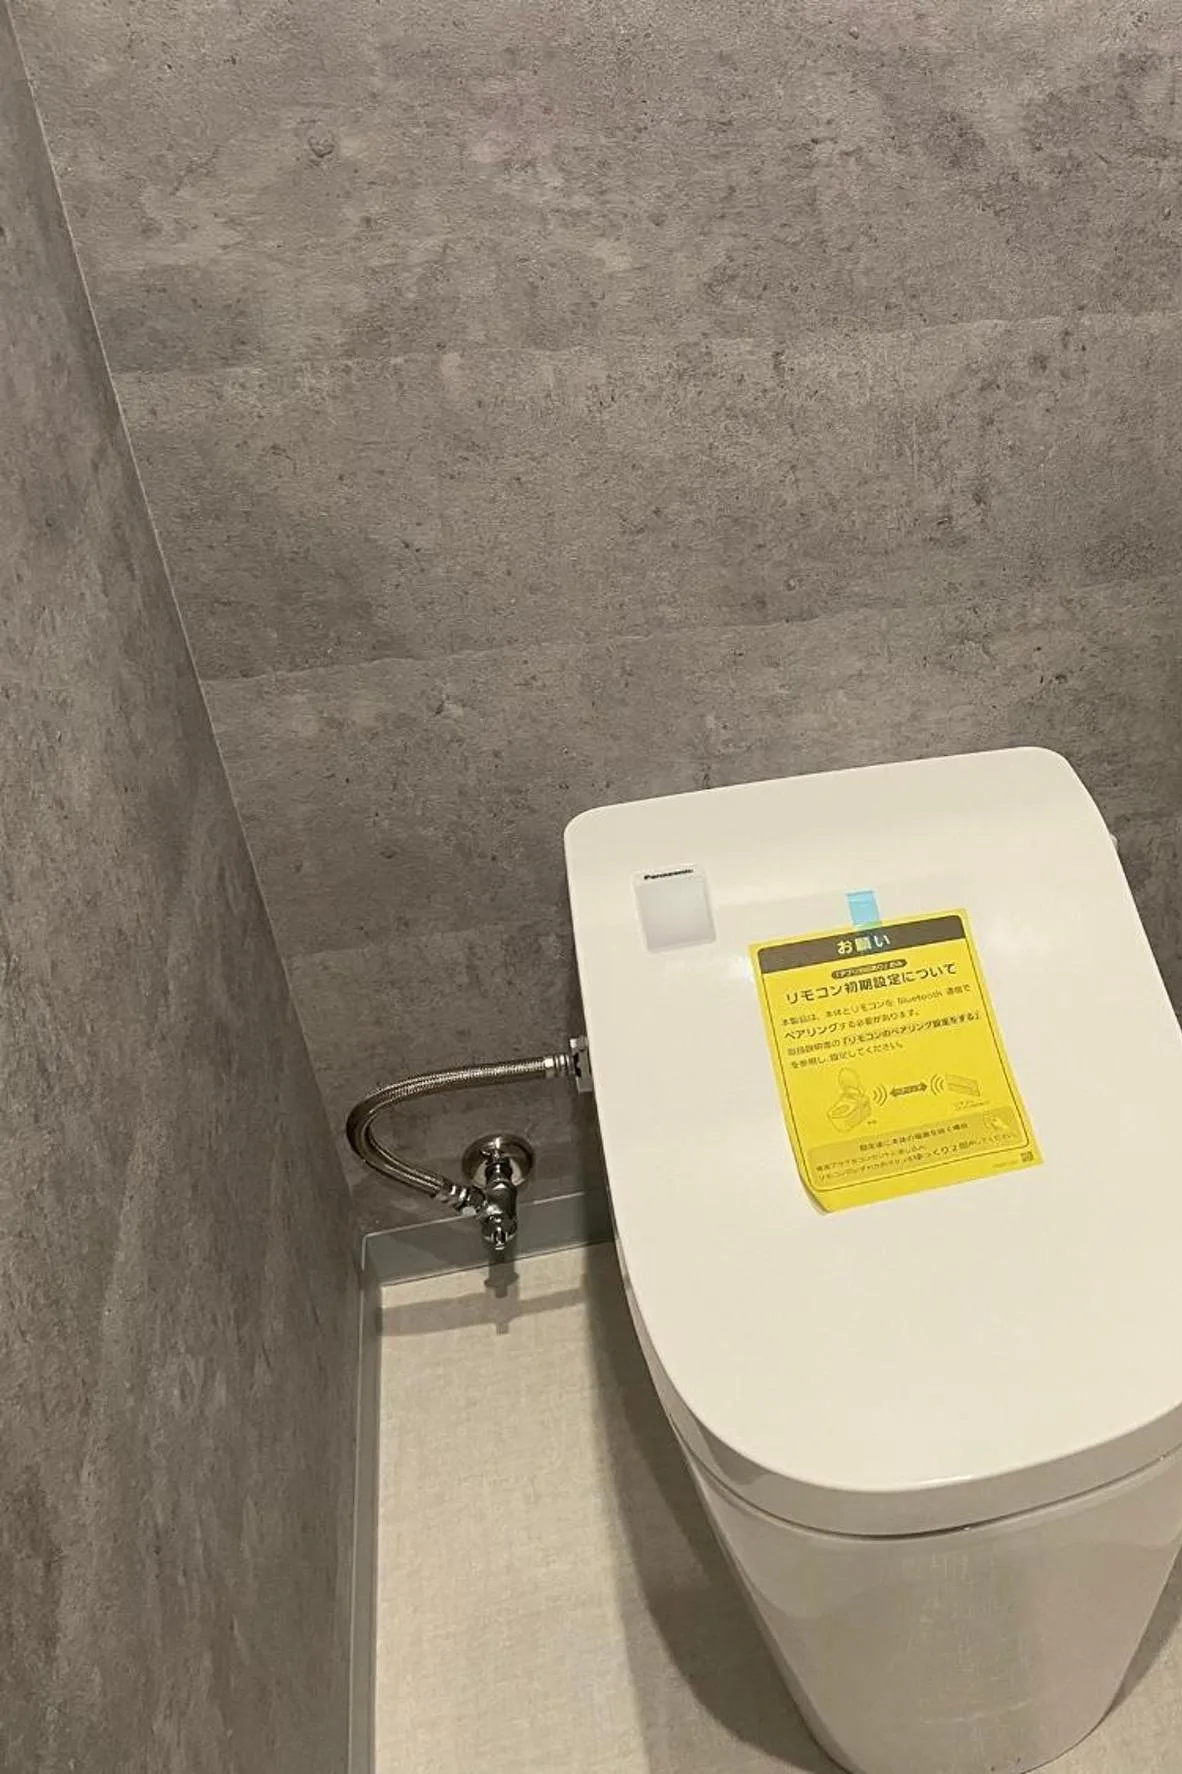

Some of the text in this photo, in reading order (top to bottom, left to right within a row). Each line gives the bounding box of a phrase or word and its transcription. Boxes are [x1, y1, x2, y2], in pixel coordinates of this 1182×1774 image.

[836, 933, 891, 955] お願い
[785, 963, 957, 1004] リモコン初期設定について
